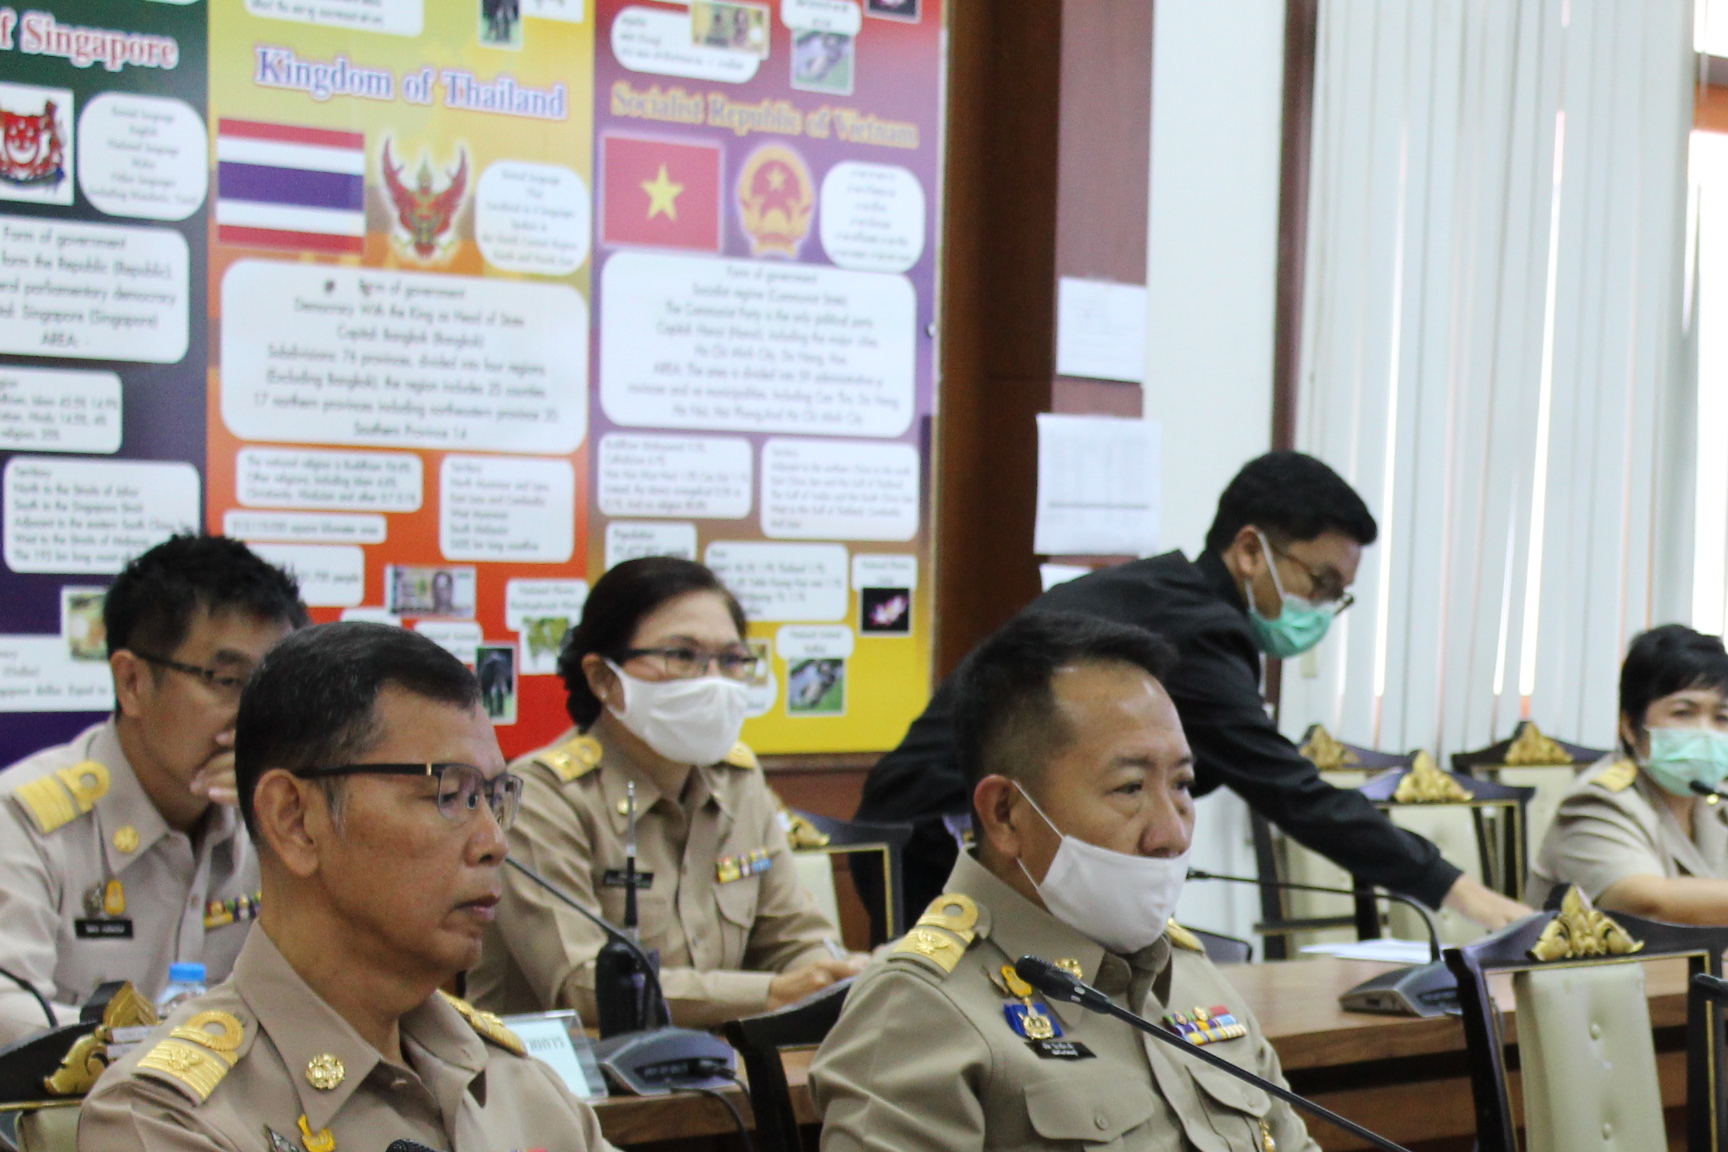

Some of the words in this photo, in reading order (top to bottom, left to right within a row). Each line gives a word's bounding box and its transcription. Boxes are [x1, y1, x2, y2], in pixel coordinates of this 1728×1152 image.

[22, 13, 179, 71] Singapore
[256, 47, 394, 102] Kingdom
[403, 68, 434, 106] of
[442, 71, 566, 120] Thailand
[611, 82, 704, 124] Socialist
[707, 92, 803, 136] Republic
[804, 104, 830, 139] of
[833, 108, 919, 150] Vietnam
